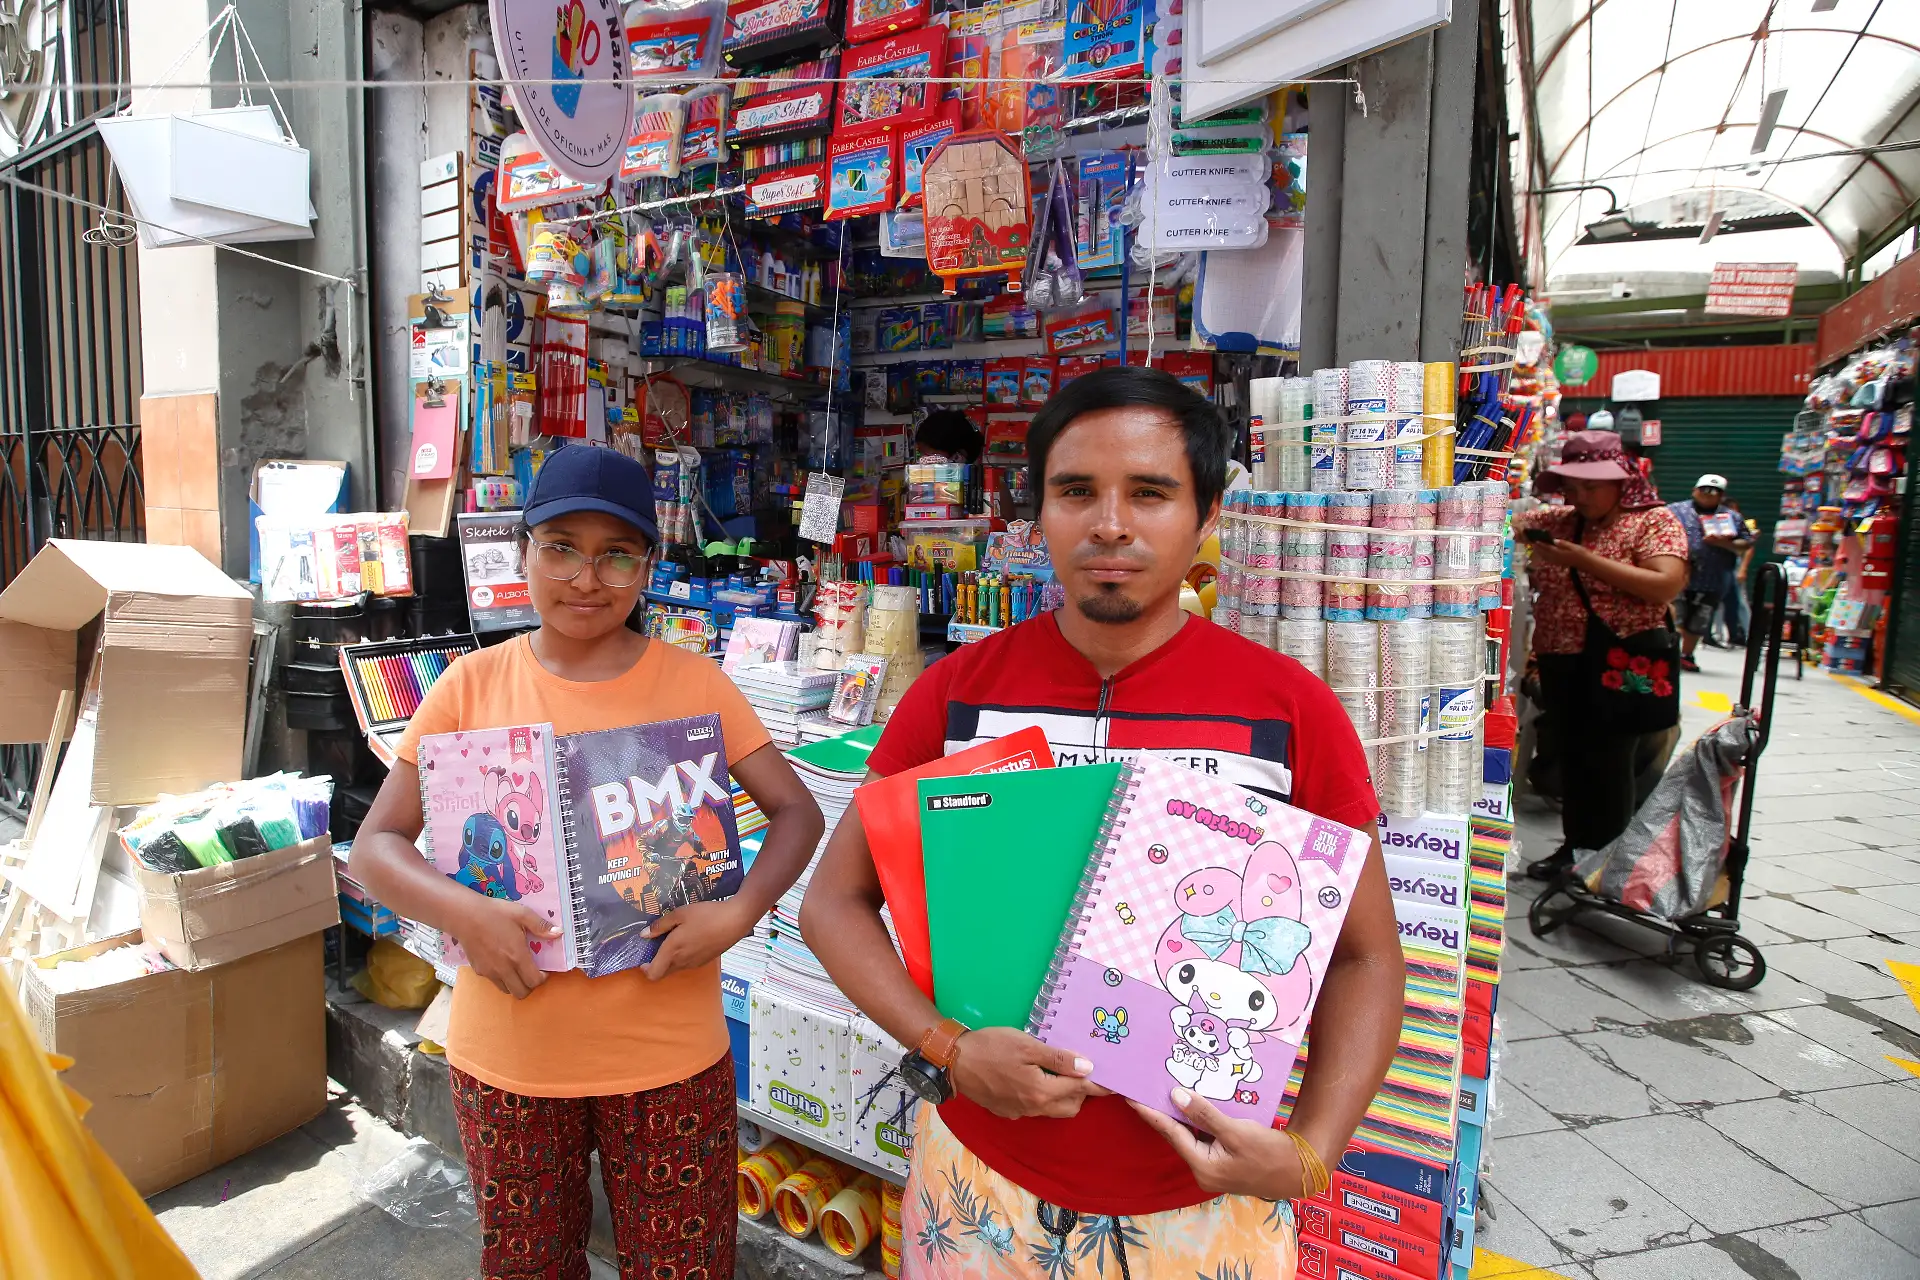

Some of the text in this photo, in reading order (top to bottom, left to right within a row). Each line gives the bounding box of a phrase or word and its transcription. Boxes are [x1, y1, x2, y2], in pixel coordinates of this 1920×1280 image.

[1090, 30, 1114, 42] STRONG
[857, 44, 921, 67] FABER-CASTELL
[515, 31, 612, 157] UTILS DE OFICINA Y MAS
[746, 99, 808, 128] Super Soft
[903, 119, 954, 140] FABER-CASTELL
[832, 134, 890, 154] FABER-CASTELL
[1172, 167, 1235, 177] CUTTER KNIFE
[760, 182, 804, 202] Super Soft
[1169, 197, 1232, 207] CUTTER KNIFE
[1166, 229, 1229, 237] CUTTER KNIFE
[590, 751, 731, 838] BMX
[942, 794, 988, 808] Standford
[1167, 798, 1264, 846] MY MELODY
[1317, 830, 1339, 845] STYLE
[1382, 832, 1460, 860] Reyser
[709, 849, 731, 862] WITH
[1312, 840, 1337, 858] BOOK
[607, 856, 629, 870] KEEP
[705, 859, 738, 876] PASSION
[598, 866, 642, 885] MOVING IT
[720, 978, 745, 997] atlas
[731, 998, 745, 1010] 100
[770, 1086, 823, 1122] alpha
[1341, 1179, 1428, 1213] laser brilliant
[1350, 1197, 1392, 1218] TRUTONE
[1339, 1218, 1425, 1256] laser brilliant
[1348, 1238, 1389, 1259] TRUTONE
